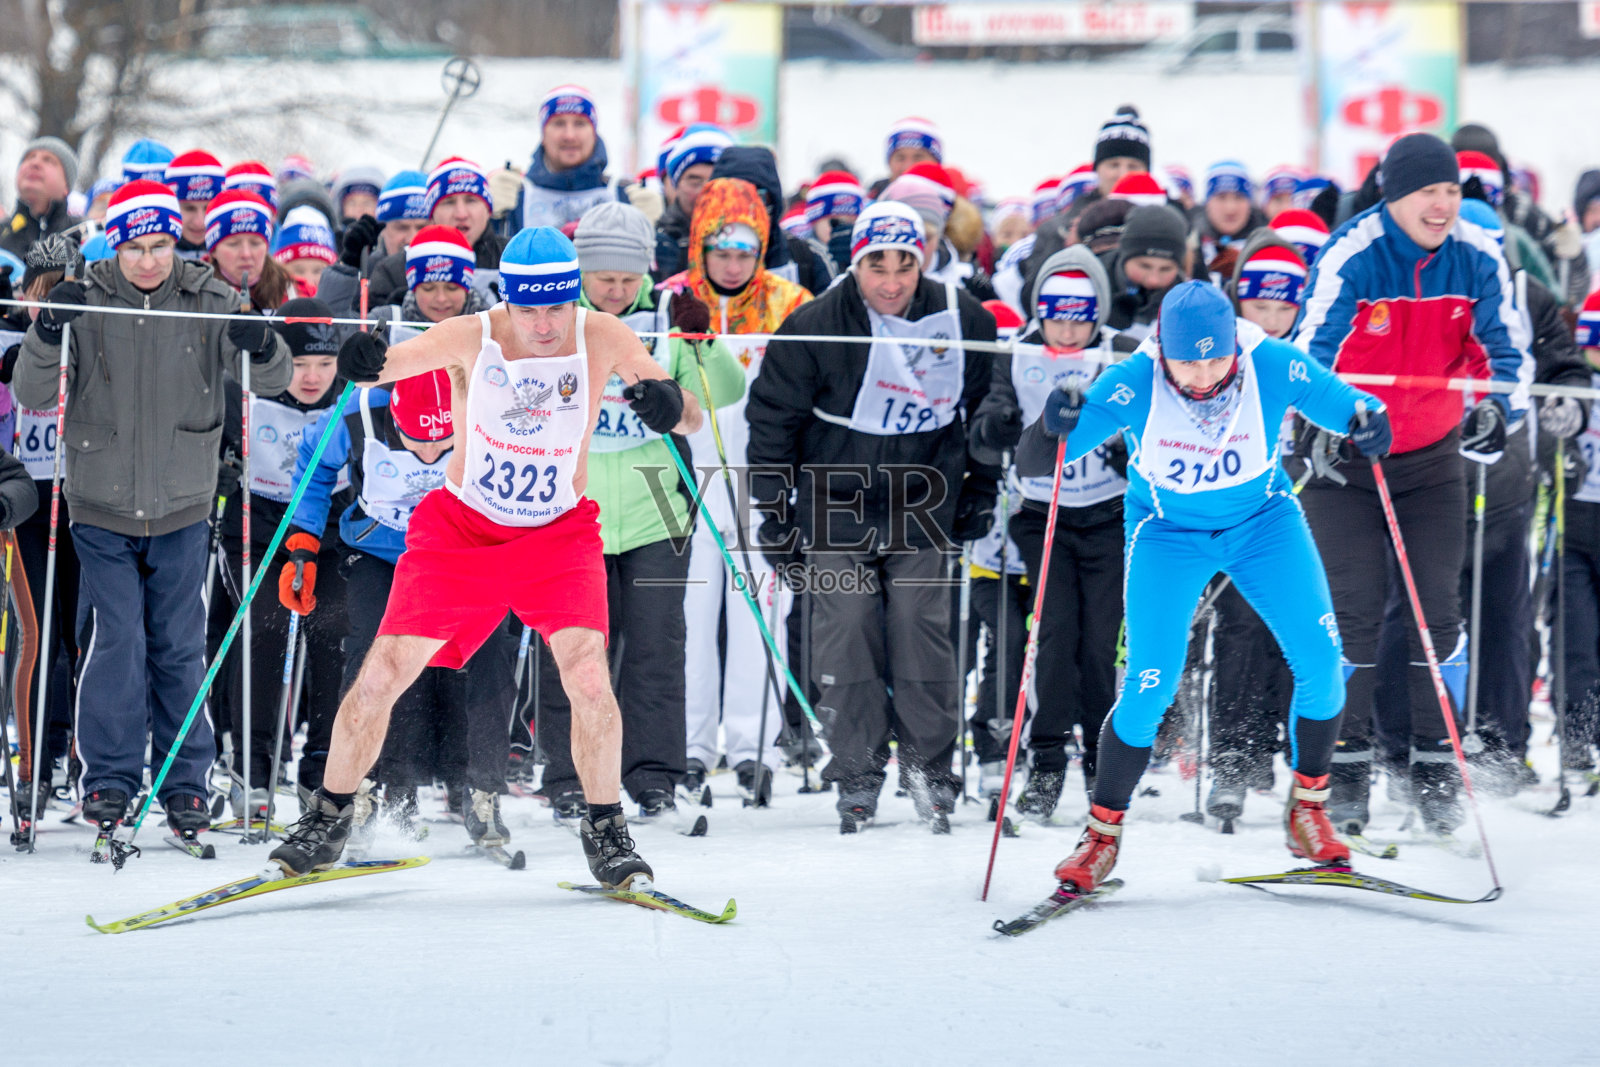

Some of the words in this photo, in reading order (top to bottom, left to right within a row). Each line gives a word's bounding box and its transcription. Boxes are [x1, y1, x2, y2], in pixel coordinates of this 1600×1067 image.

[127, 223, 163, 240] 2014
[517, 278, 580, 293] РОССИИ
[514, 377, 546, 390] ЫЖНЯ
[419, 408, 452, 428] DNB
[531, 409, 551, 417] 2014
[505, 422, 543, 436] РОССИИ
[506, 443, 545, 456] РОССИИ
[1158, 438, 1196, 451] ЛЫЖНЯ
[479, 452, 558, 503] 2323
[516, 506, 551, 519] Марий
